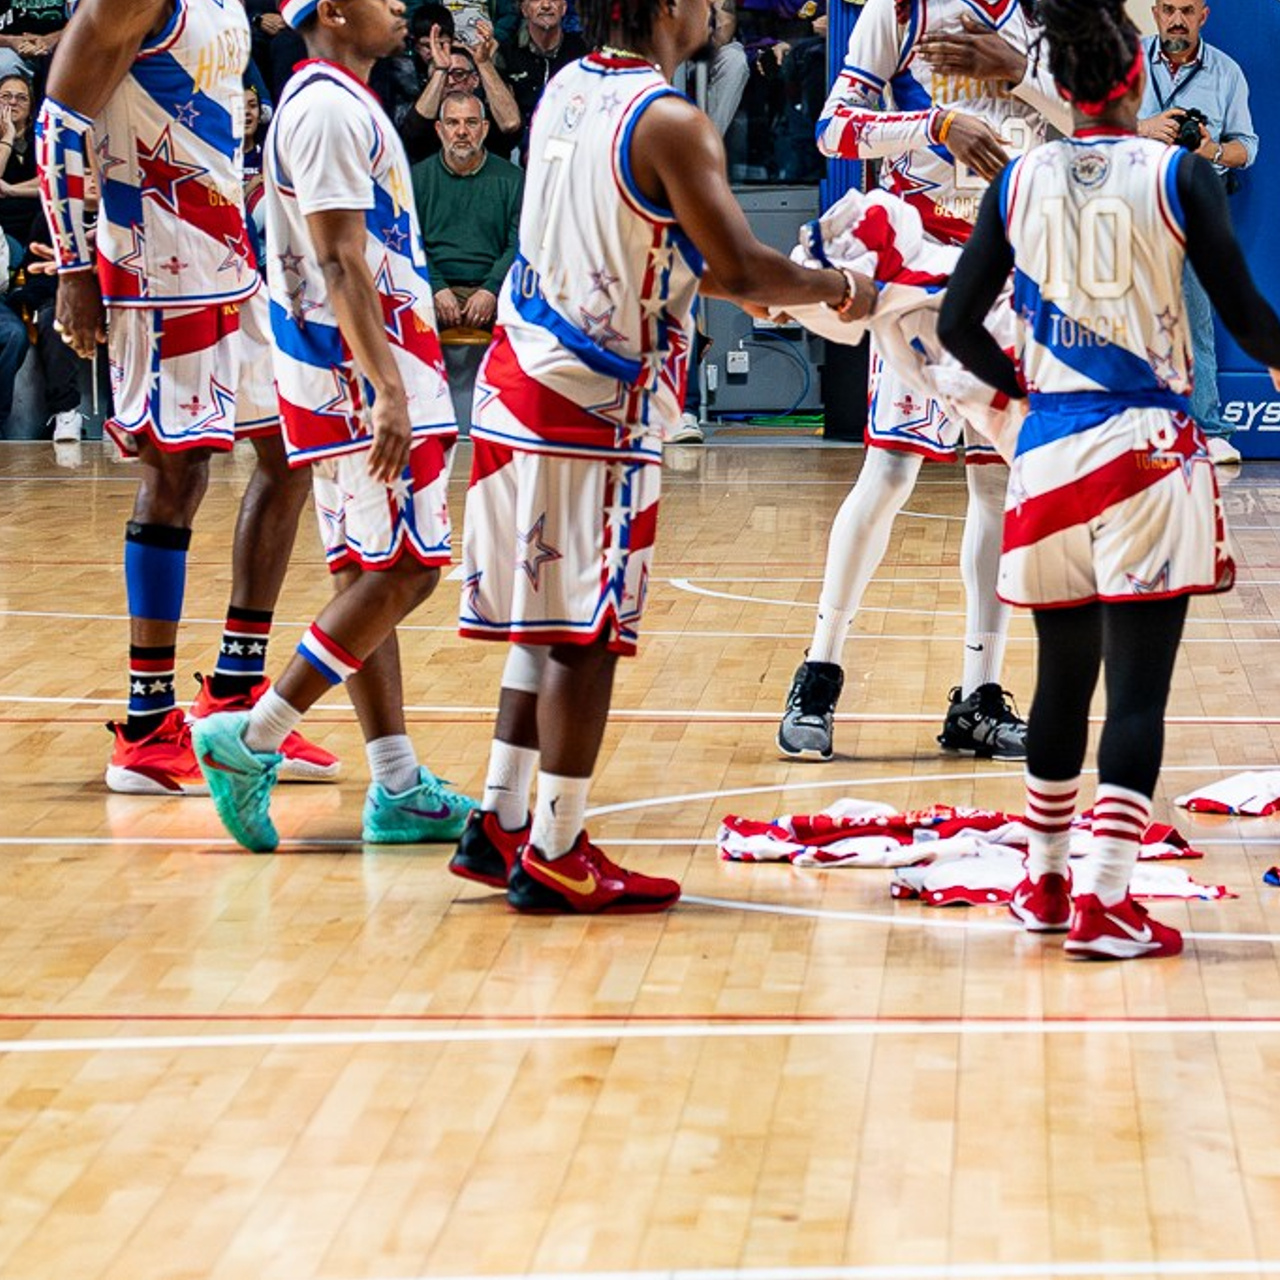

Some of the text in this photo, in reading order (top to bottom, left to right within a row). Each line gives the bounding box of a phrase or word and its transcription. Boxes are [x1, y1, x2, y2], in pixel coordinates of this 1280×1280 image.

[543, 135, 577, 251] 7
[1040, 195, 1134, 300] 10
[1050, 313, 1129, 348] TORCH
